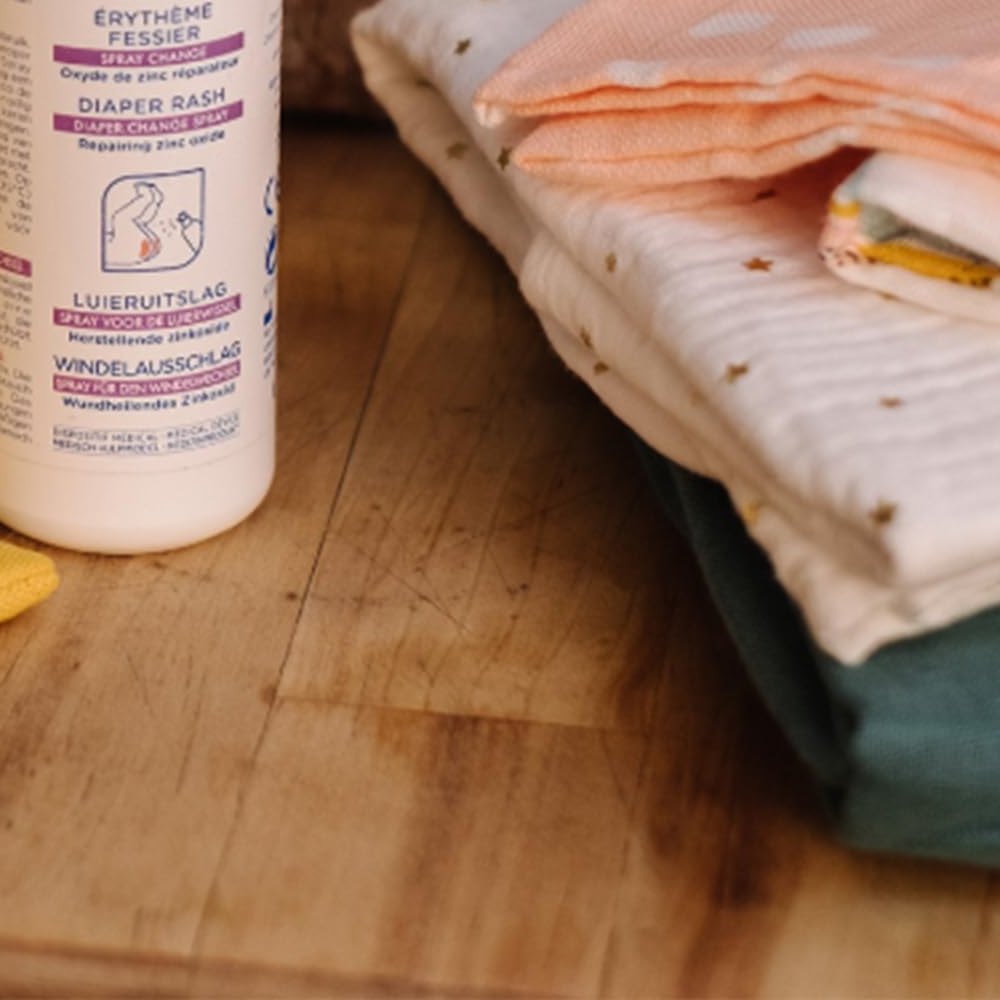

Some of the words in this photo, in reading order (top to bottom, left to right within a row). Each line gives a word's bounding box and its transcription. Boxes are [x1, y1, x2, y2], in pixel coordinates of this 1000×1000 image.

[94, 1, 213, 27] ÉRYTHÈME
[108, 25, 201, 47] FESSIER
[100, 52, 145, 66] SPRAY
[148, 46, 208, 65] CHANGE
[59, 66, 108, 83] Oxyde
[113, 70, 132, 83] de
[138, 69, 168, 83] zinc
[78, 96, 163, 114] DIAPER
[172, 87, 226, 111] RASH
[73, 119, 124, 134] DIAPER
[127, 119, 189, 134] CHANGE
[192, 110, 230, 128] SPRAY
[78, 137, 151, 153] Repairing
[156, 136, 185, 150] zinc
[73, 281, 228, 311] LUIERUITSLAG
[53, 340, 242, 377] WINDELAUSSCHLAG
